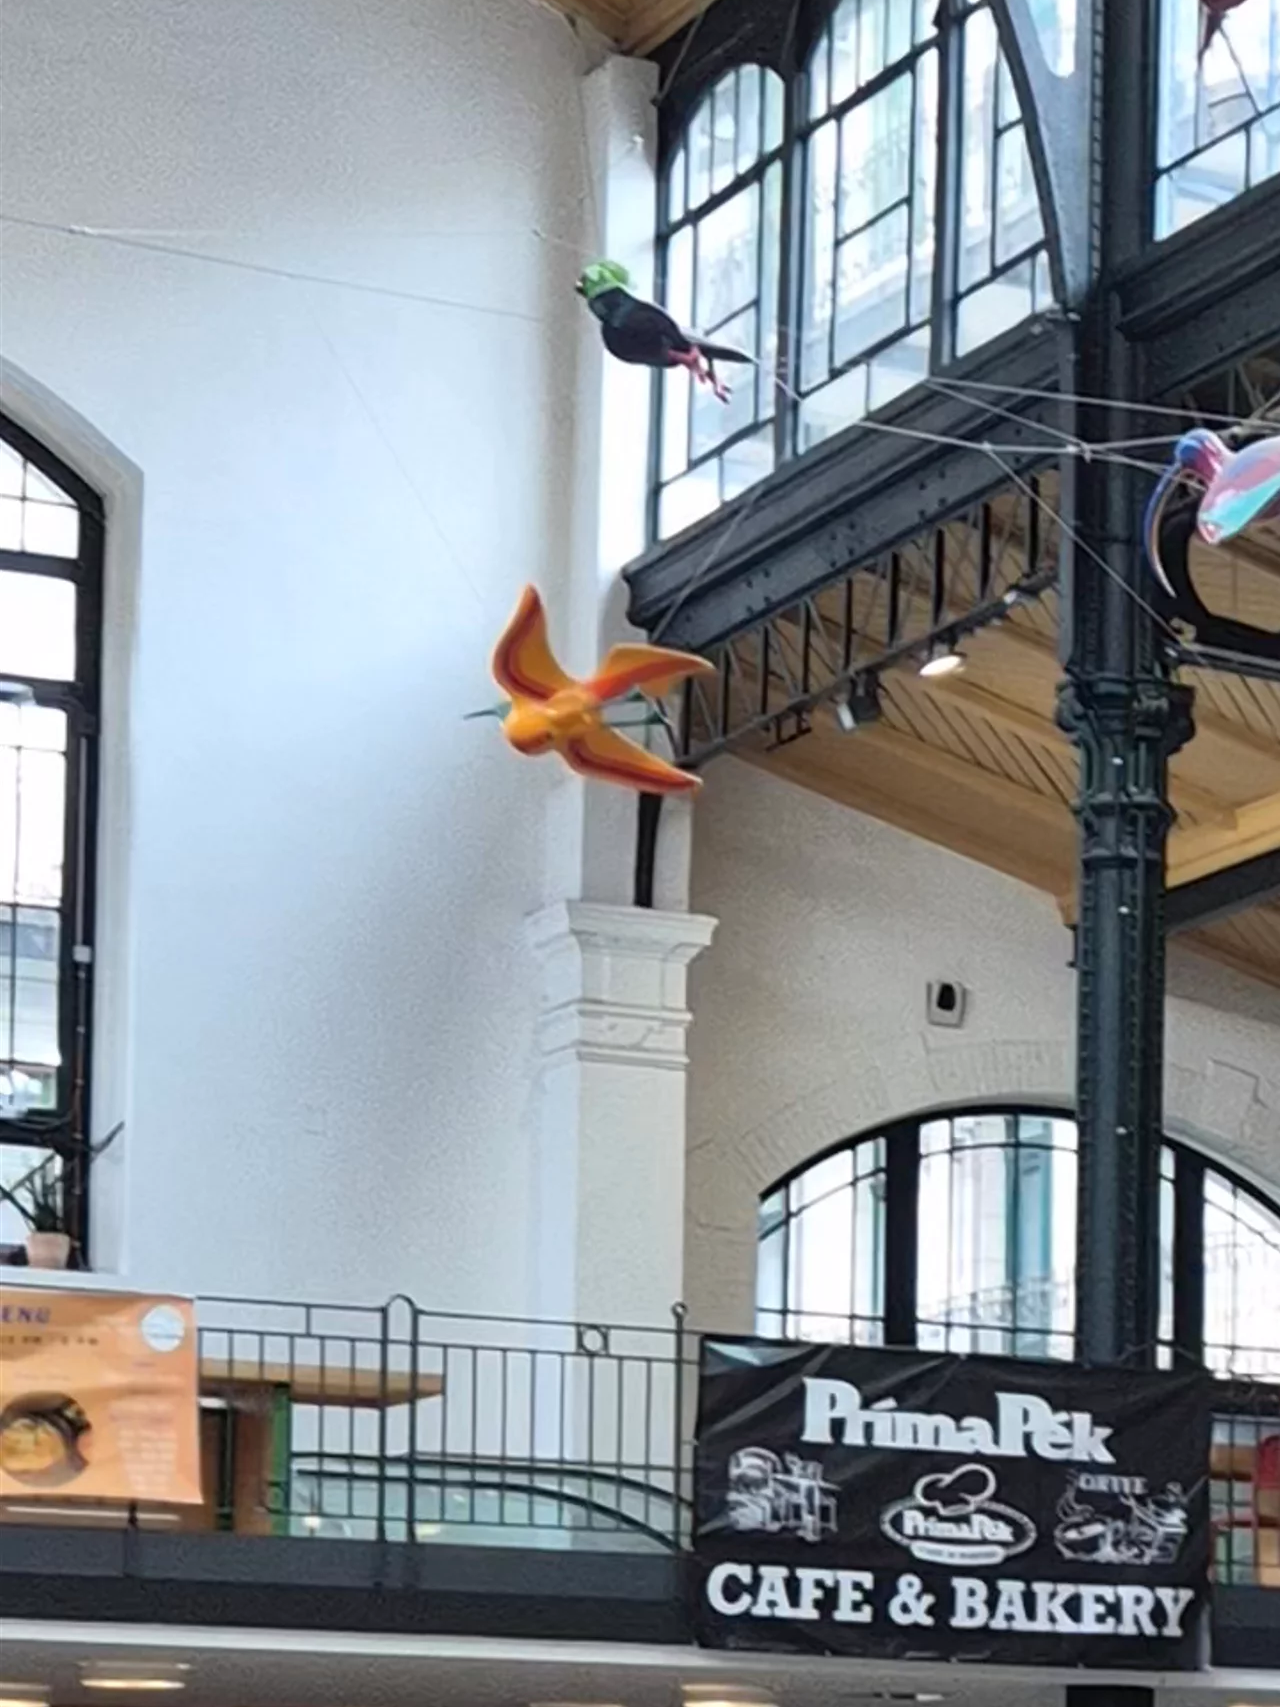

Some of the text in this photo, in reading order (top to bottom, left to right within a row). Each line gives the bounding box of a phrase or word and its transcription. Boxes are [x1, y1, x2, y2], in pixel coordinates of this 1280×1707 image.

[706, 1562, 1196, 1638] CAFE & BAKERY
